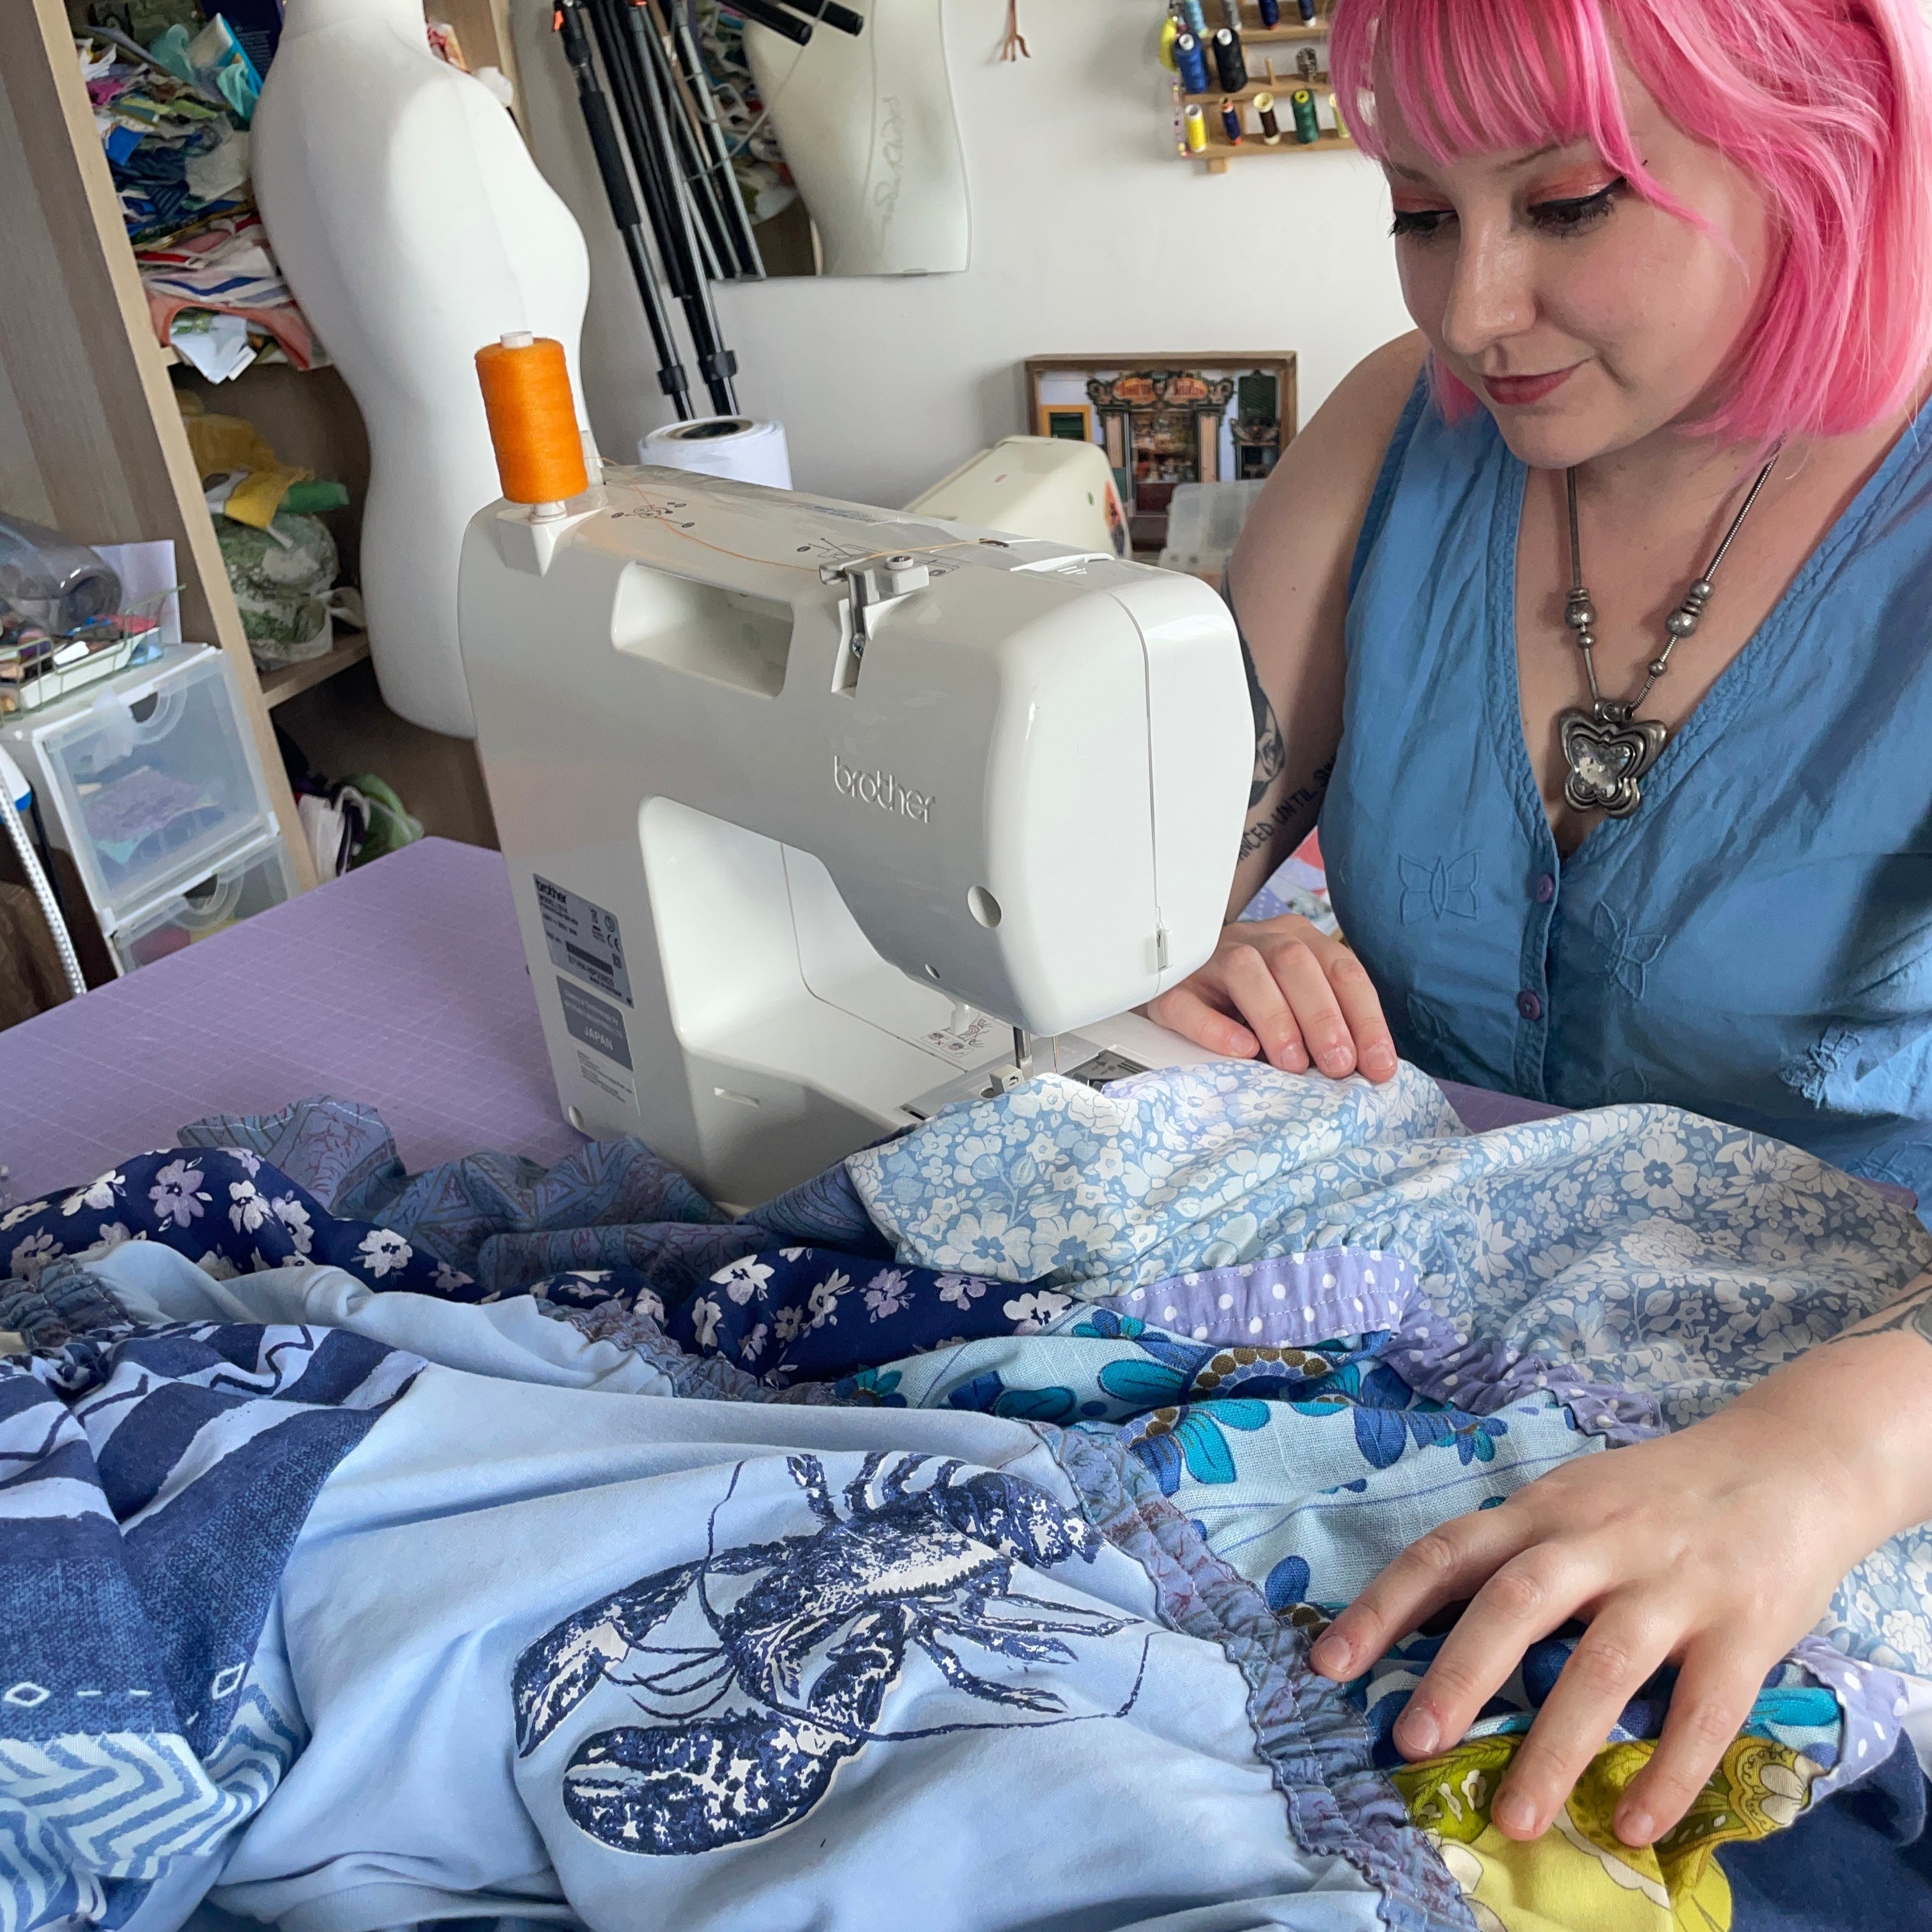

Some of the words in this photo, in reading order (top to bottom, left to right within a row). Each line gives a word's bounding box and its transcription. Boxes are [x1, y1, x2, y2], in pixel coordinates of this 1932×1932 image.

[834, 755, 936, 824] brother
[1269, 786, 1319, 825] UNTIL
[535, 878, 567, 905] brother
[585, 1026, 613, 1051] JAPAN
